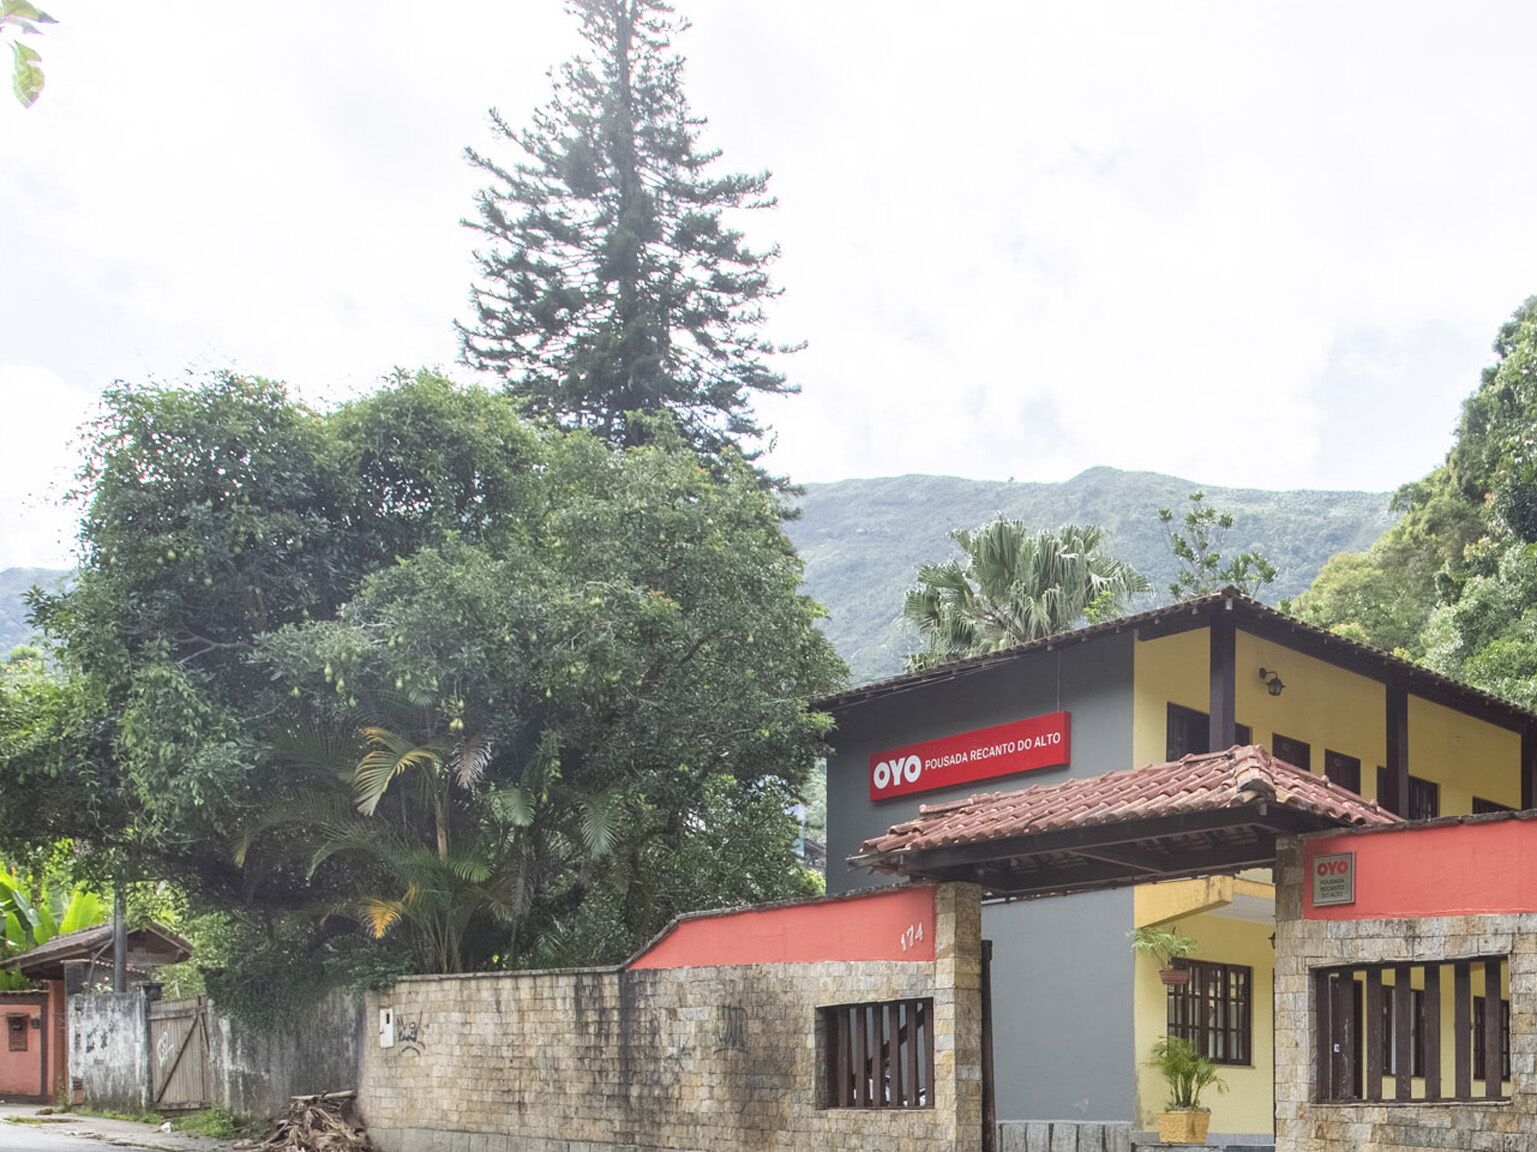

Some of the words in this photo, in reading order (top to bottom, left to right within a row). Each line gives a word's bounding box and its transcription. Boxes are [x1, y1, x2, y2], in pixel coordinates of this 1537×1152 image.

[873, 755, 922, 790] OYO
[925, 752, 968, 770] POUSADA
[970, 741, 1015, 761] RECANTO
[1017, 738, 1032, 751] DO
[1034, 732, 1061, 748] ALTO
[1318, 861, 1348, 876] OYO
[900, 922, 924, 951] 174
